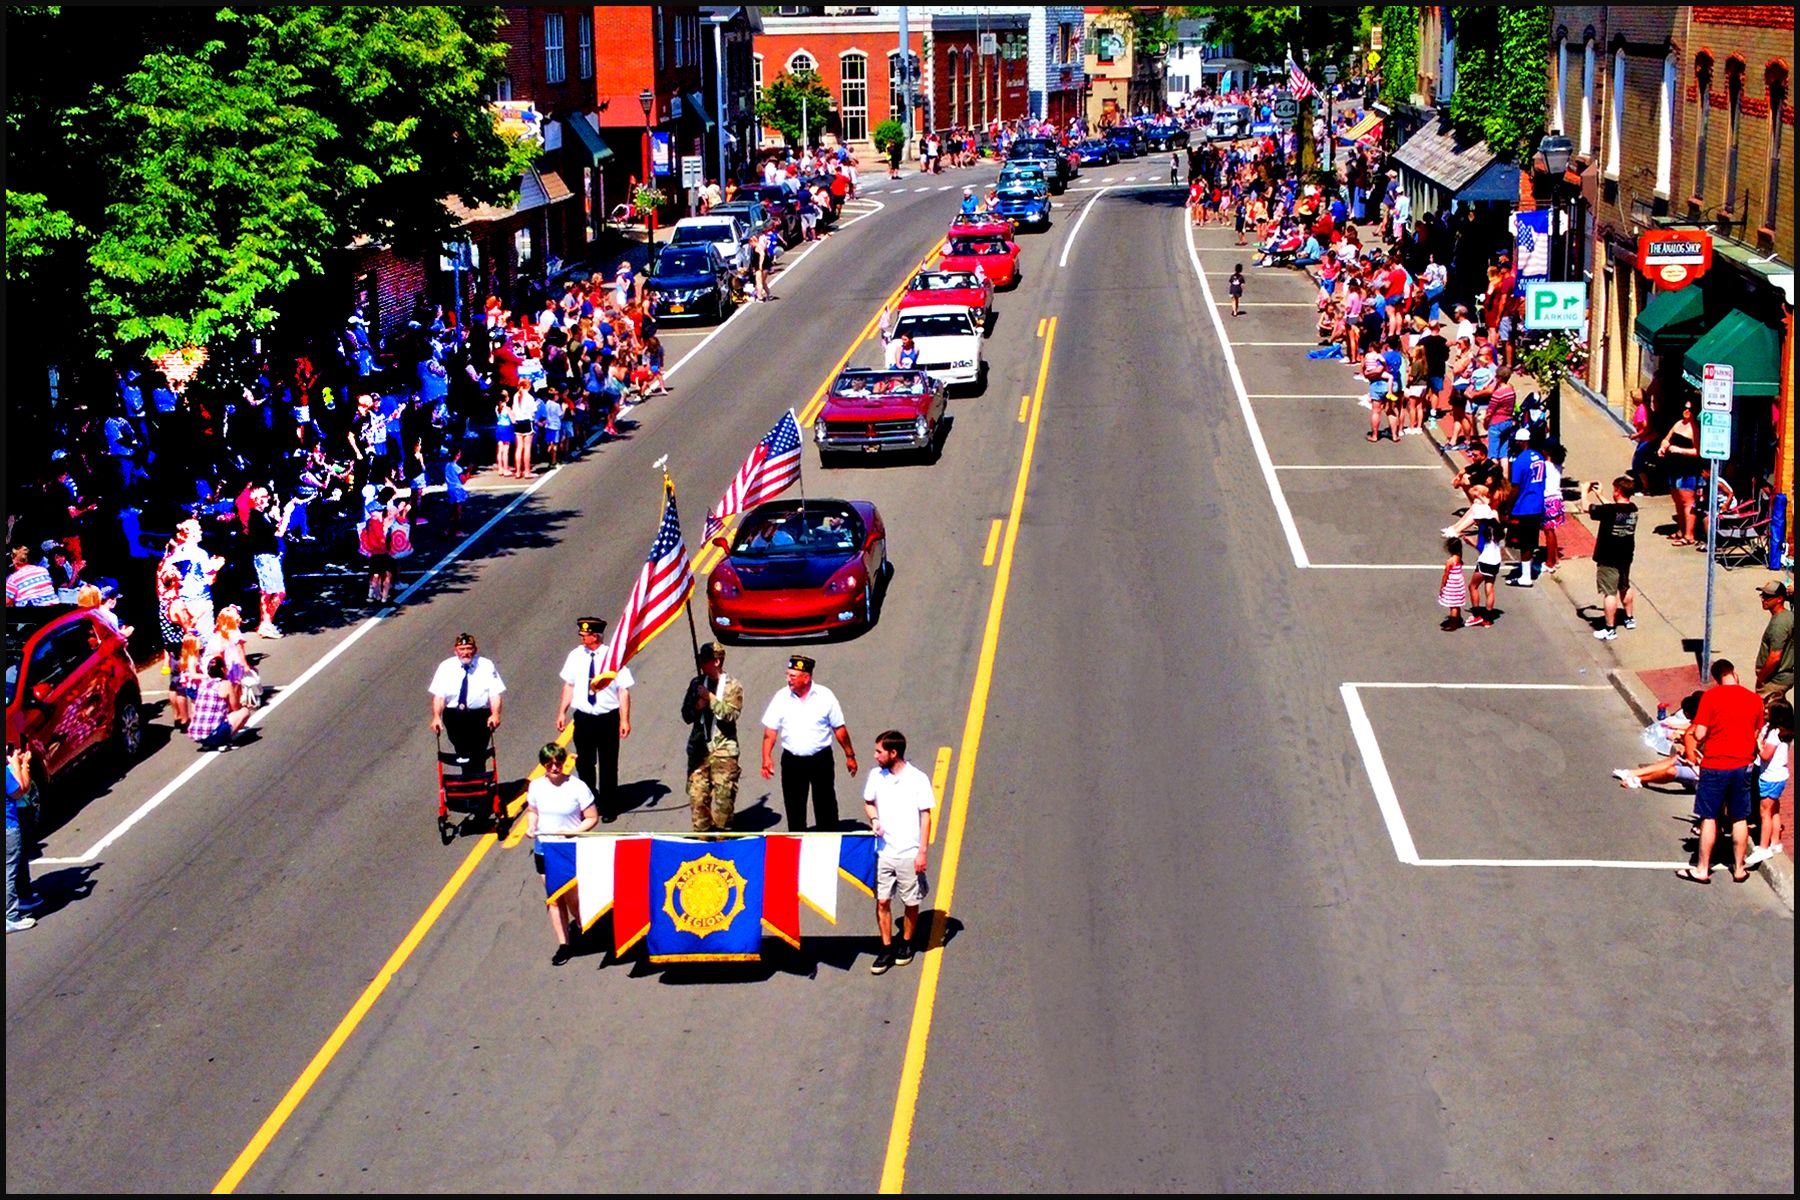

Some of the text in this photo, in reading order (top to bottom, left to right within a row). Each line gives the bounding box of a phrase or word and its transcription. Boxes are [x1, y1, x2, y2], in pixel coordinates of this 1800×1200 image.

[1276, 104, 1295, 112] 444
[1649, 242, 1701, 254] THE ANALOG SHOP
[1704, 413, 1712, 424] 2
[676, 863, 737, 889] AMERICAN
[681, 912, 724, 928] LEGION
